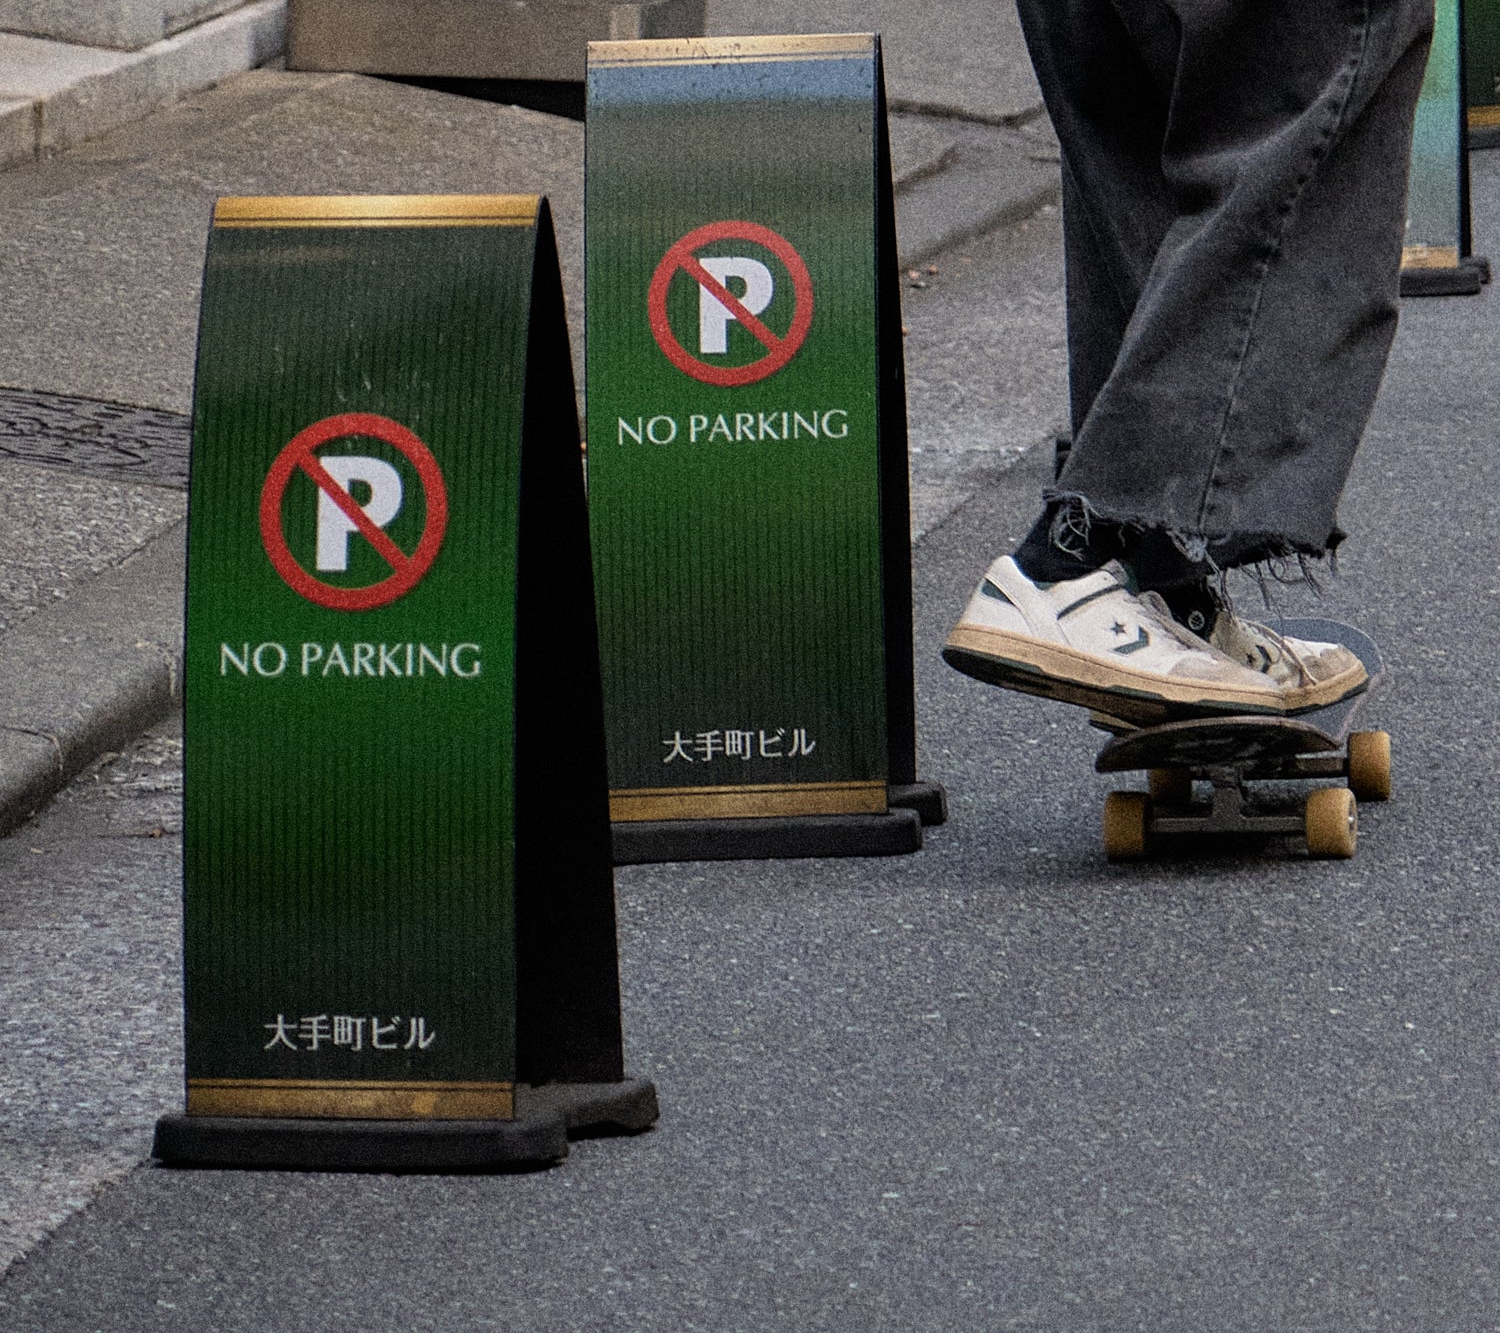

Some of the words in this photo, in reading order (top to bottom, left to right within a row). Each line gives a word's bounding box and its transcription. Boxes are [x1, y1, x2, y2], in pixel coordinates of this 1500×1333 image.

[617, 415, 678, 446] NO
[688, 408, 849, 444] PARKING
[219, 641, 288, 677] NO
[300, 641, 482, 678] PARKING
[662, 727, 817, 764] 大手町ビル
[263, 1013, 436, 1052] 大手町ビル
